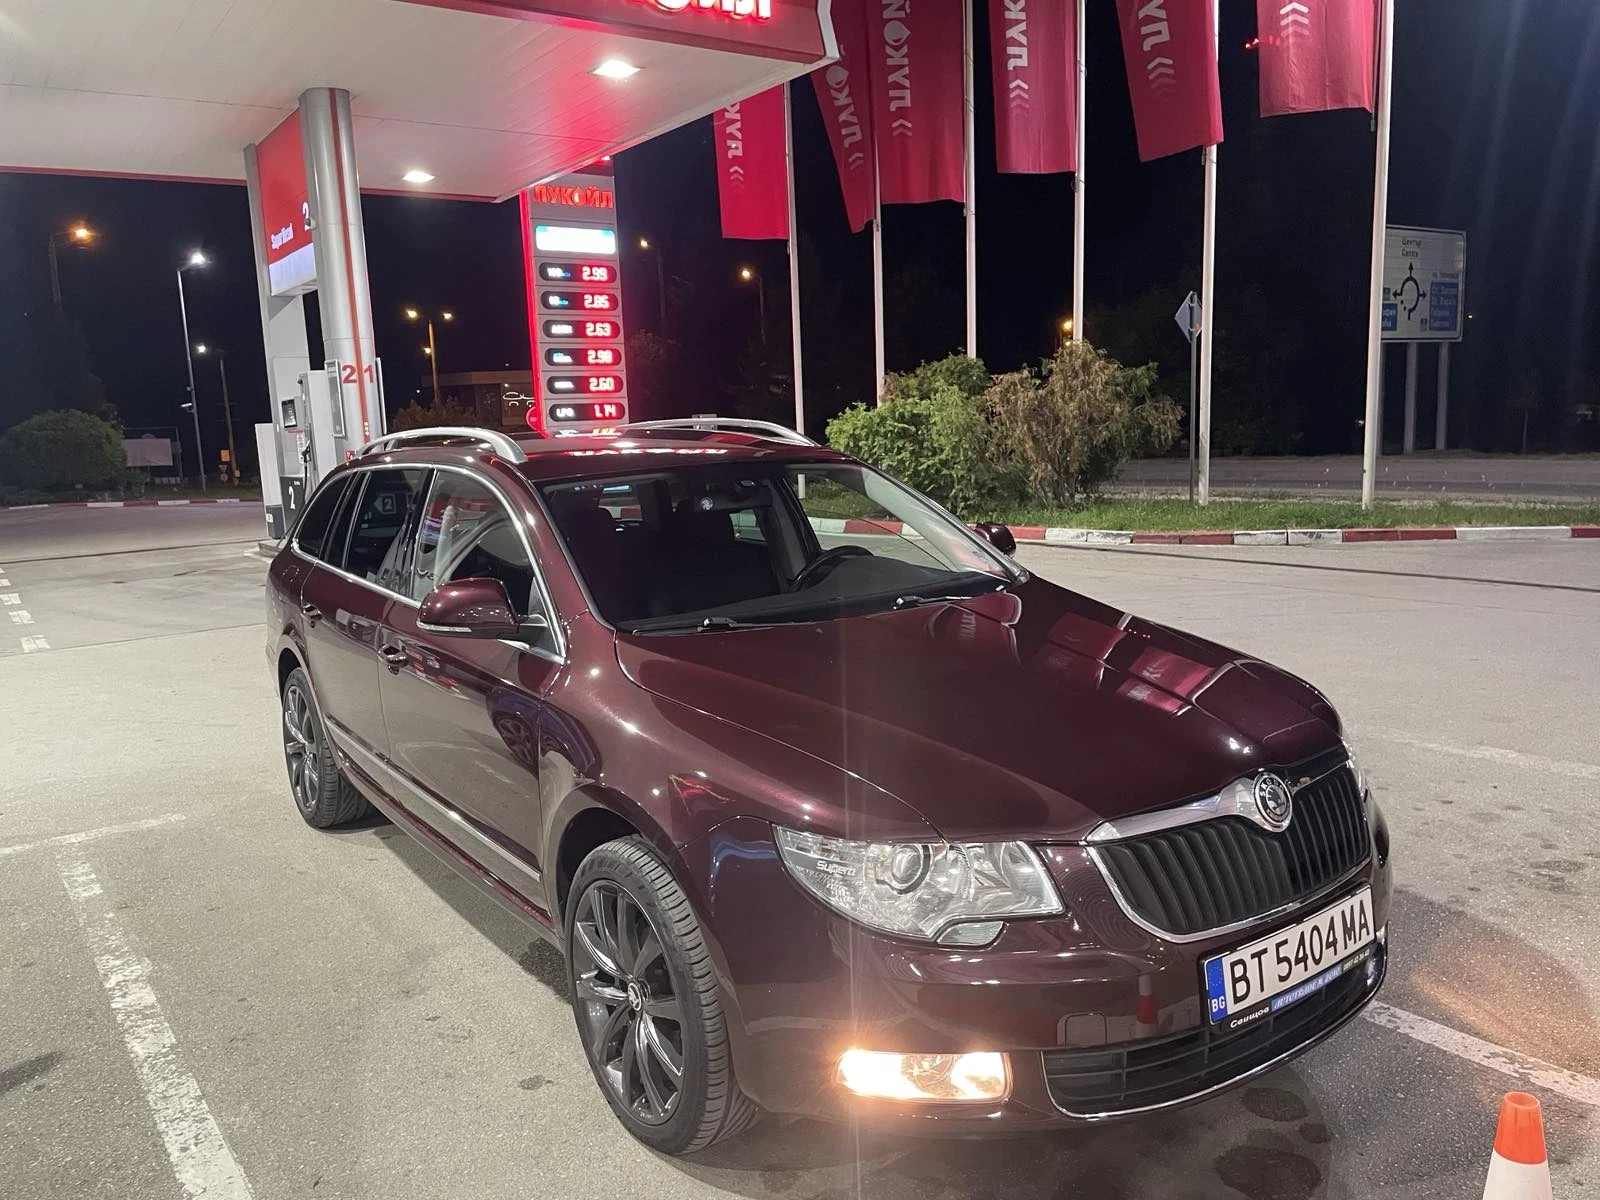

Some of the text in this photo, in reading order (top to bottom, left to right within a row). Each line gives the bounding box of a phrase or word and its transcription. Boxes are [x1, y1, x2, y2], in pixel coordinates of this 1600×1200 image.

[1004, 0, 1029, 71] ЛУК
[882, 0, 911, 112] ЛУКОЙ
[825, 62, 863, 149] ЛУКО
[724, 102, 743, 159] ЛУК
[534, 184, 614, 209] ЛУКОЙЛ
[583, 294, 610, 309] 2.85
[585, 322, 611, 337] 2.63
[1211, 996, 1226, 1013] BG
[1230, 1006, 1270, 1028] Свищов
